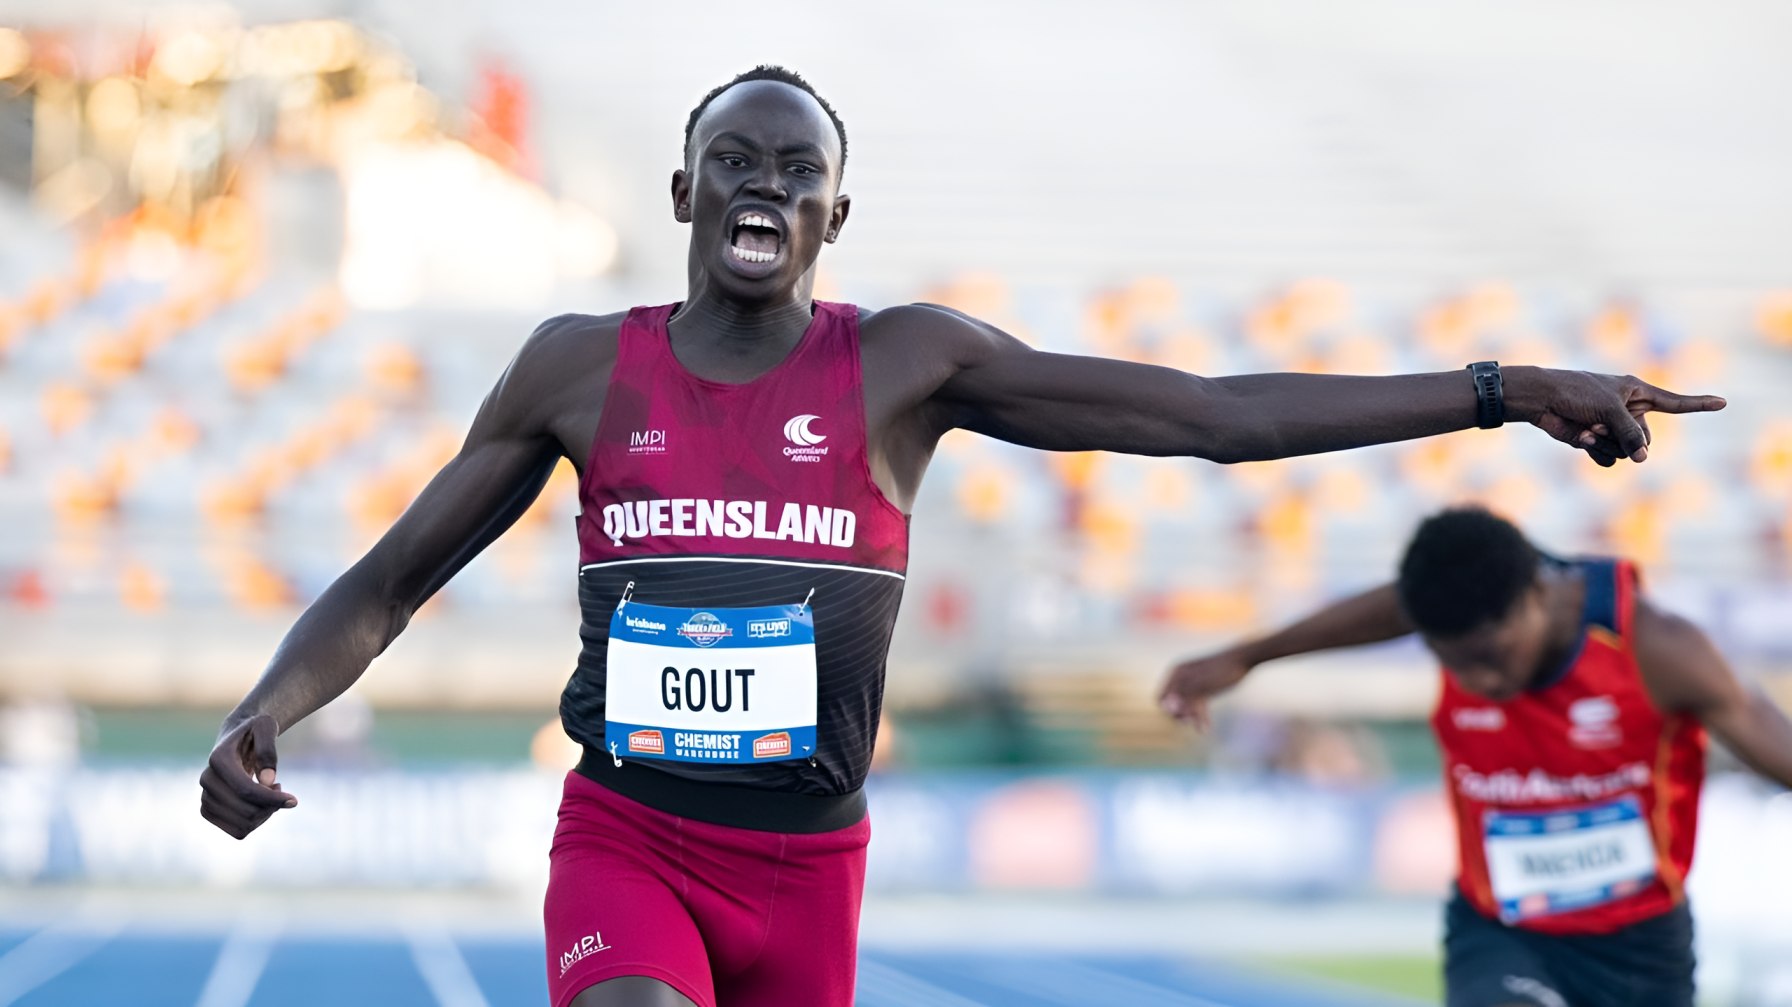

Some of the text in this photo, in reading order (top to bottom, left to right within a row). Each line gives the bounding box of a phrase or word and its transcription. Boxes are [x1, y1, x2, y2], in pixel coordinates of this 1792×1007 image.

[630, 430, 666, 446] IMPI
[602, 498, 857, 548] QUEENSLAND
[661, 666, 755, 713] GOUT
[674, 732, 741, 750] CHEMIST
